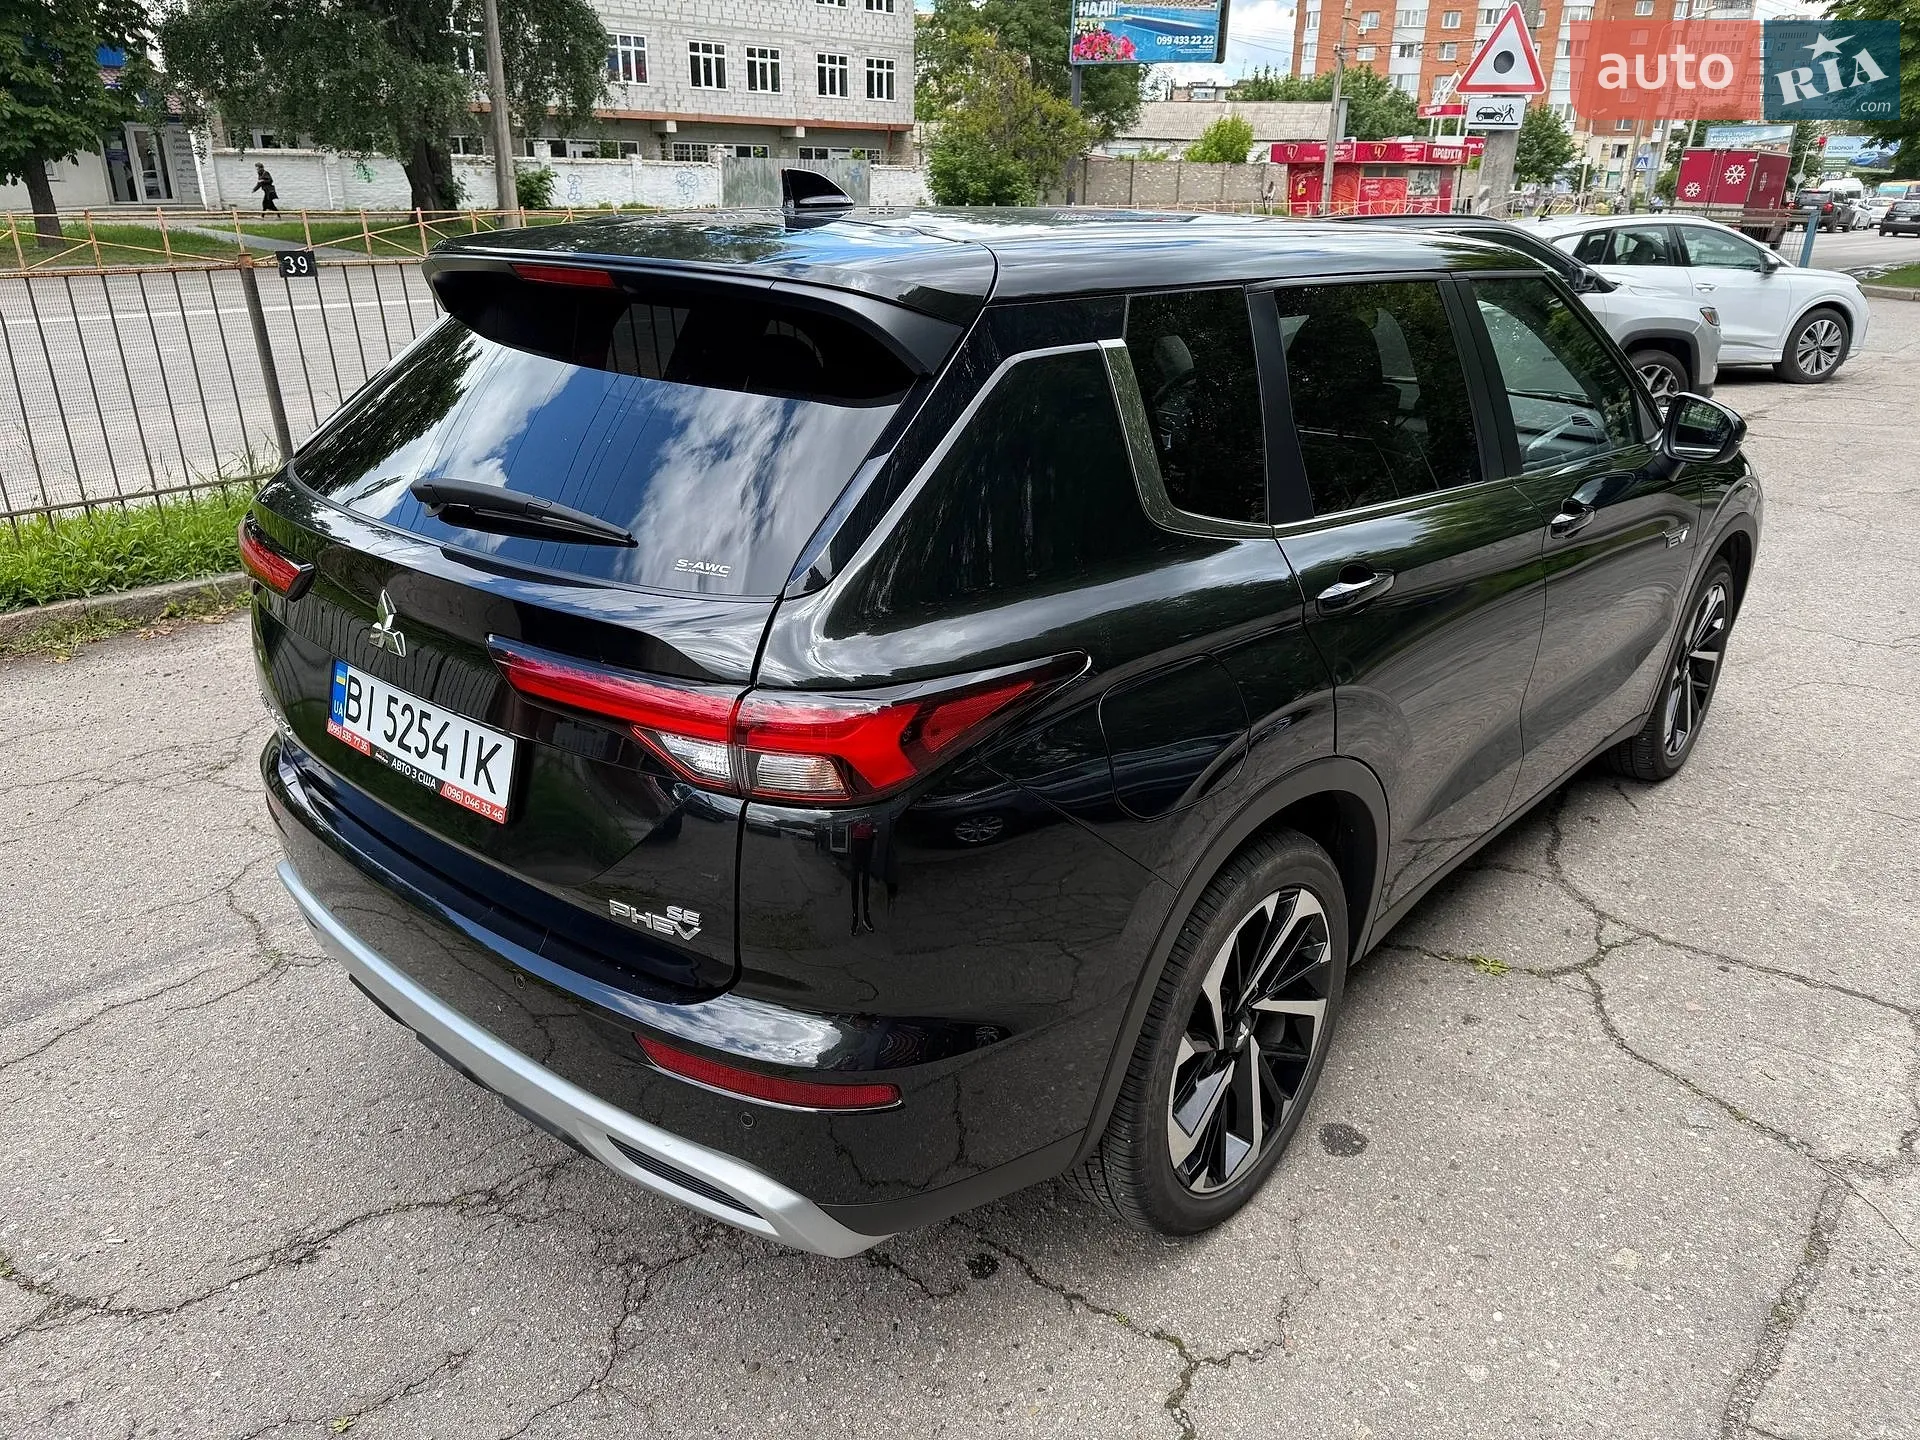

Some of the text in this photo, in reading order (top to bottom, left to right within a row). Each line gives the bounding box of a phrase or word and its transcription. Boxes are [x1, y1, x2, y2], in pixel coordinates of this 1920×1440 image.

[1156, 35, 1214, 45] 099 433 22 22
[283, 256, 308, 274] 39
[676, 559, 731, 574] S-AWC
[333, 700, 343, 717] UA
[345, 675, 375, 732] BI
[383, 695, 450, 771] 5254
[460, 730, 502, 795] IK
[391, 758, 411, 776] АВТО
[418, 772, 436, 790] США
[445, 783, 503, 820] (096) 046 33 46
[609, 899, 702, 941] PHEV
[666, 905, 701, 927] SE
